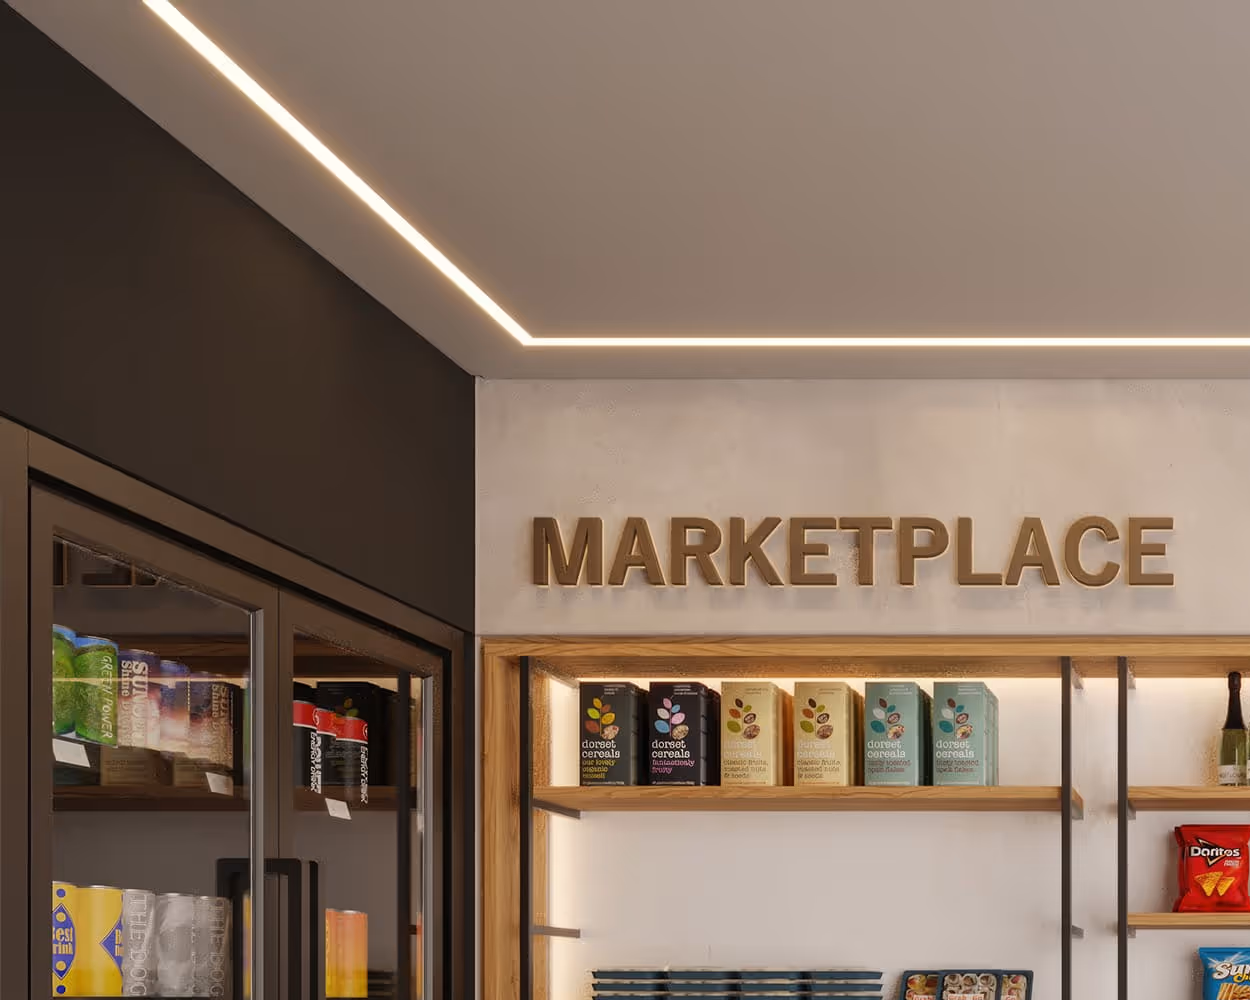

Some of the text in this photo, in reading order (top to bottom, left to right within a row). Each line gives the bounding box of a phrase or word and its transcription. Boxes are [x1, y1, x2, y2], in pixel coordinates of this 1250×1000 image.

[532, 515, 1175, 586] MARKETPLACE
[101, 655, 113, 739] GREEN POWER
[581, 740, 616, 749] dorset
[651, 740, 686, 749] dorset
[867, 740, 902, 749] dorset
[935, 740, 970, 749] dorset
[581, 749, 620, 758] cereals
[651, 749, 690, 758] cereals
[867, 749, 906, 758] cereals
[935, 749, 974, 758] cereals
[1190, 846, 1240, 857] Doritos
[53, 927, 73, 942] est
